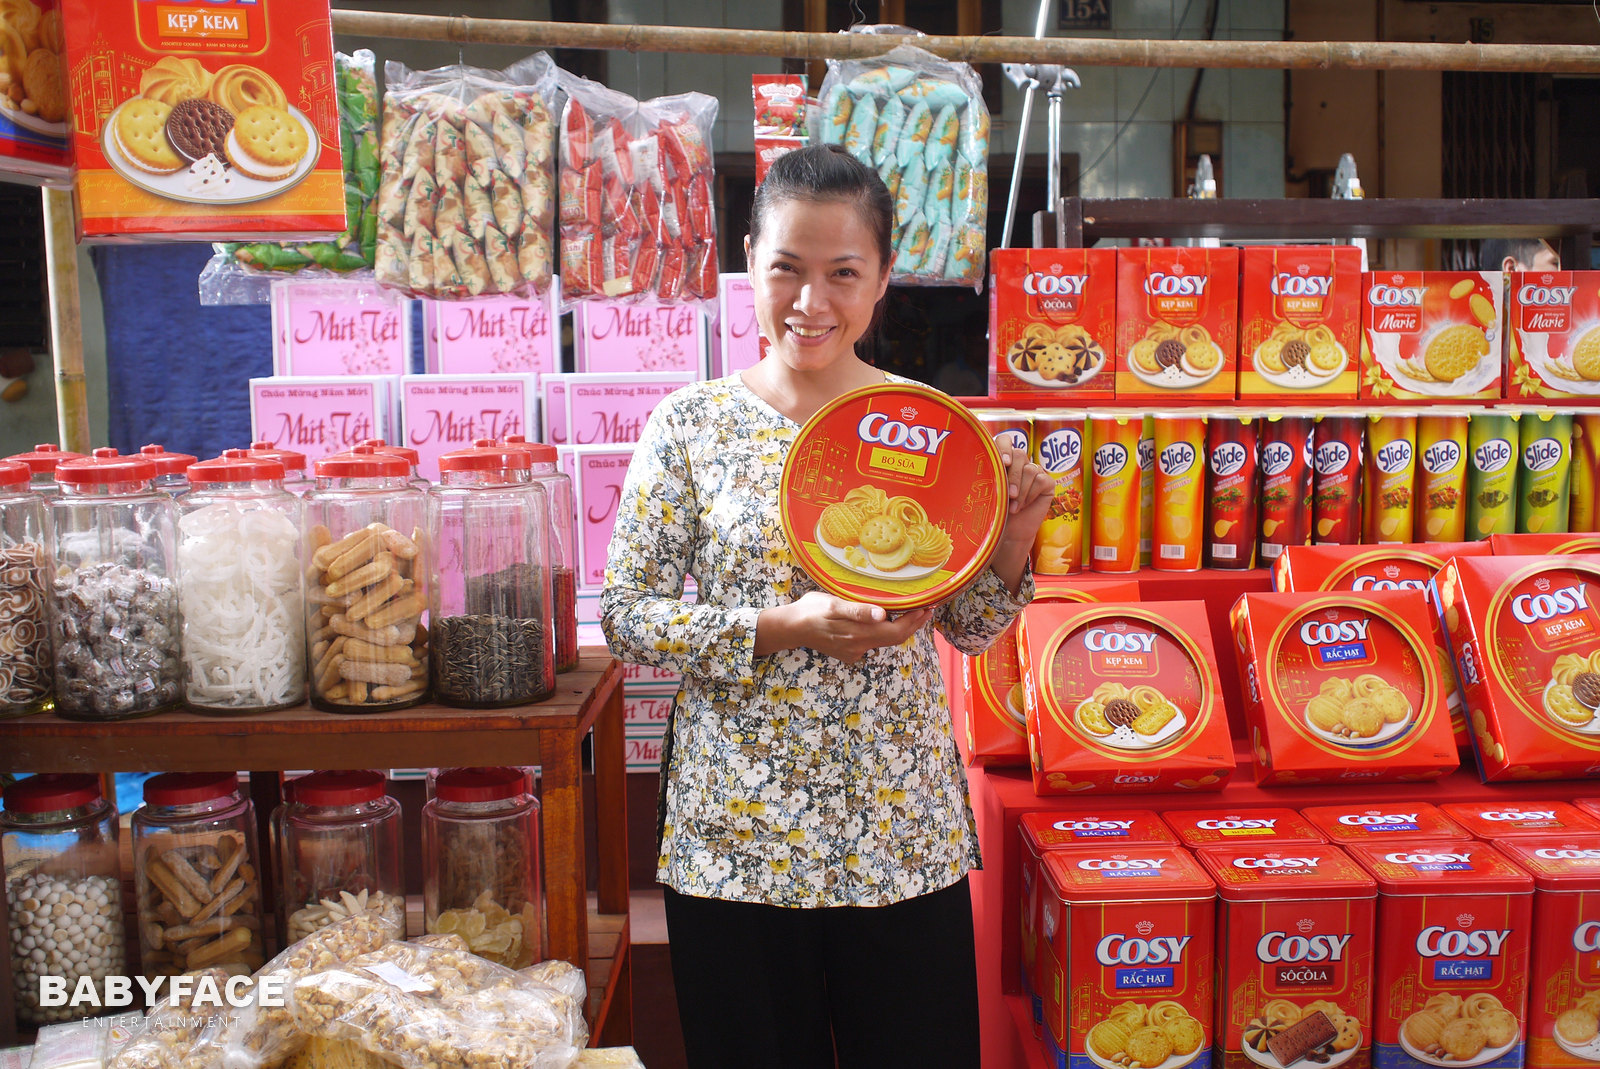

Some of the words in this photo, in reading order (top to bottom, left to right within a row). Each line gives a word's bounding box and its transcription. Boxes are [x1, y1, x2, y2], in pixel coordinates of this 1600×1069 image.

[167, 13, 198, 32] KẸP
[203, 15, 239, 30] KEM
[1023, 271, 1090, 296] COSY
[1144, 271, 1208, 296] COSY
[1270, 272, 1334, 297] COSY
[1368, 284, 1429, 306] COSY
[1517, 283, 1578, 306] COSY
[1040, 299, 1073, 310] ÔCÔLA
[1379, 313, 1417, 330] Marie
[1528, 313, 1565, 330] Marie
[577, 387, 602, 396] Chúc
[857, 411, 952, 456] COSY
[1040, 431, 1080, 470] Slide
[1093, 444, 1124, 476] Slide
[1160, 443, 1192, 475] Slide
[1212, 445, 1244, 474] Slide
[1262, 445, 1290, 474] Slide
[1315, 445, 1347, 474] Slide
[1378, 442, 1410, 472] Slide
[1424, 442, 1457, 472] Slide
[1474, 441, 1508, 471] Slide
[1525, 441, 1559, 471] Slide
[1512, 584, 1588, 625] COSY
[1300, 618, 1371, 646] COSY
[1545, 624, 1563, 637] KẸP
[1564, 618, 1586, 632] KEM
[1083, 628, 1159, 653] COSY
[1105, 657, 1123, 667] KẸP
[1124, 657, 1143, 666] KEM
[1463, 642, 1480, 685] COSY
[1247, 663, 1259, 704] COSY
[1113, 774, 1160, 784] COSY
[1052, 819, 1135, 831] COSY
[1196, 818, 1278, 830] COSY
[1338, 813, 1419, 826] COSY
[1480, 810, 1558, 821] COSY
[1076, 857, 1168, 870] COSY
[1232, 857, 1320, 869] COSY
[1385, 852, 1472, 864] COSY
[1534, 848, 1600, 860] COS
[1095, 933, 1193, 967] COSY
[1256, 931, 1354, 965] COSY
[1416, 925, 1514, 959] COSY
[1122, 971, 1144, 985] RẮC
[1146, 973, 1166, 986] HẠT
[1280, 969, 1327, 981] SÔCÔLA
[1440, 963, 1462, 977] RẮC
[1464, 965, 1484, 977] HẠT
